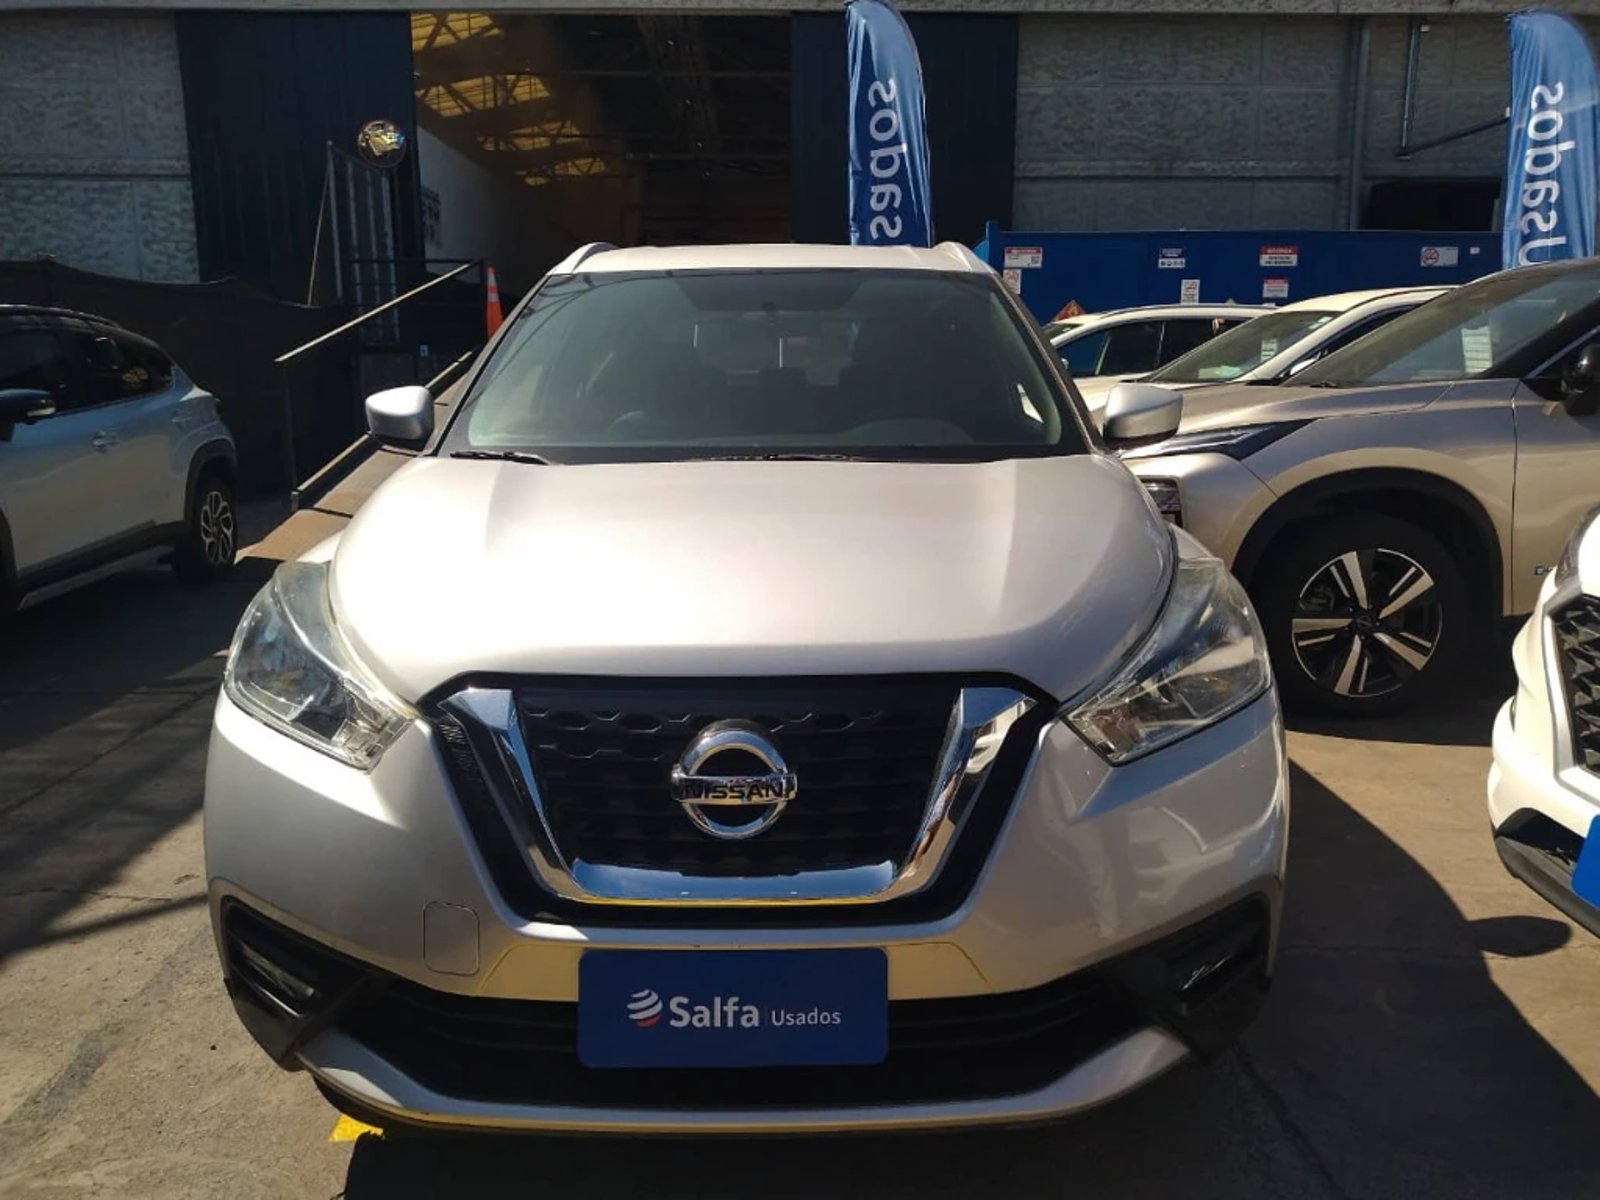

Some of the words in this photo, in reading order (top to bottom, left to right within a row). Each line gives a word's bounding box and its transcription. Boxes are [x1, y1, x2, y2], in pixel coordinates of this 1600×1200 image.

[684, 782, 783, 799] NISSAN
[669, 996, 760, 1028] Salfa
[771, 1008, 842, 1026] Usados
